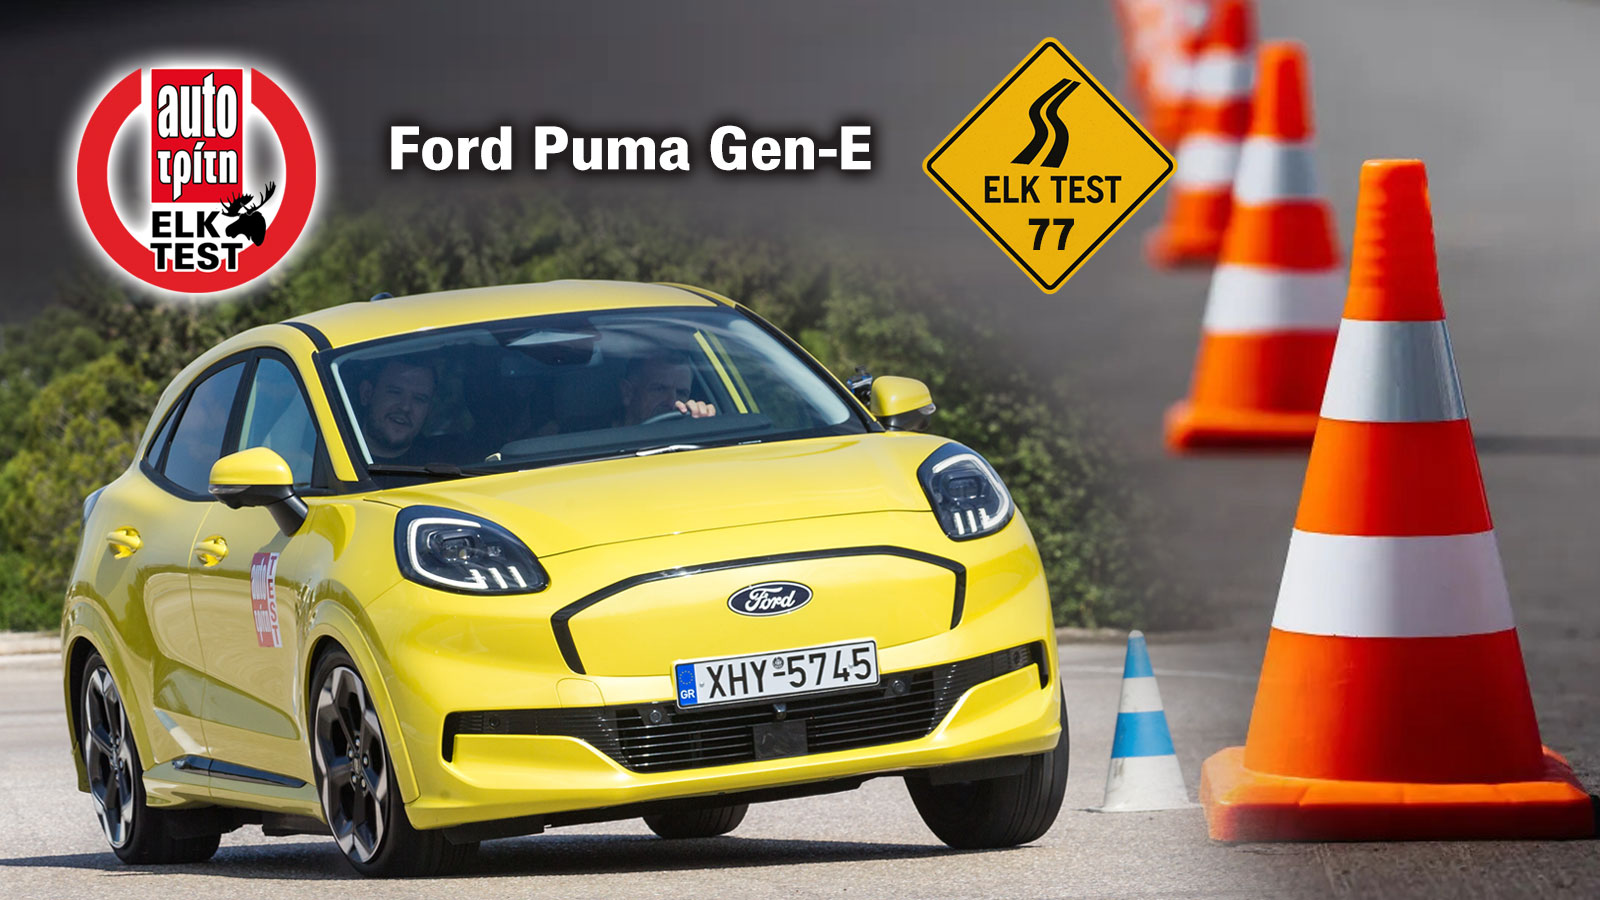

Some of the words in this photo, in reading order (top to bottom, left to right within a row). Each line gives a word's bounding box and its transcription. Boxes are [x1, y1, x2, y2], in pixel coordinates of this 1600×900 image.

[267, 555, 280, 646] TEST
[744, 586, 796, 612] Ford
[680, 689, 695, 700] GR
